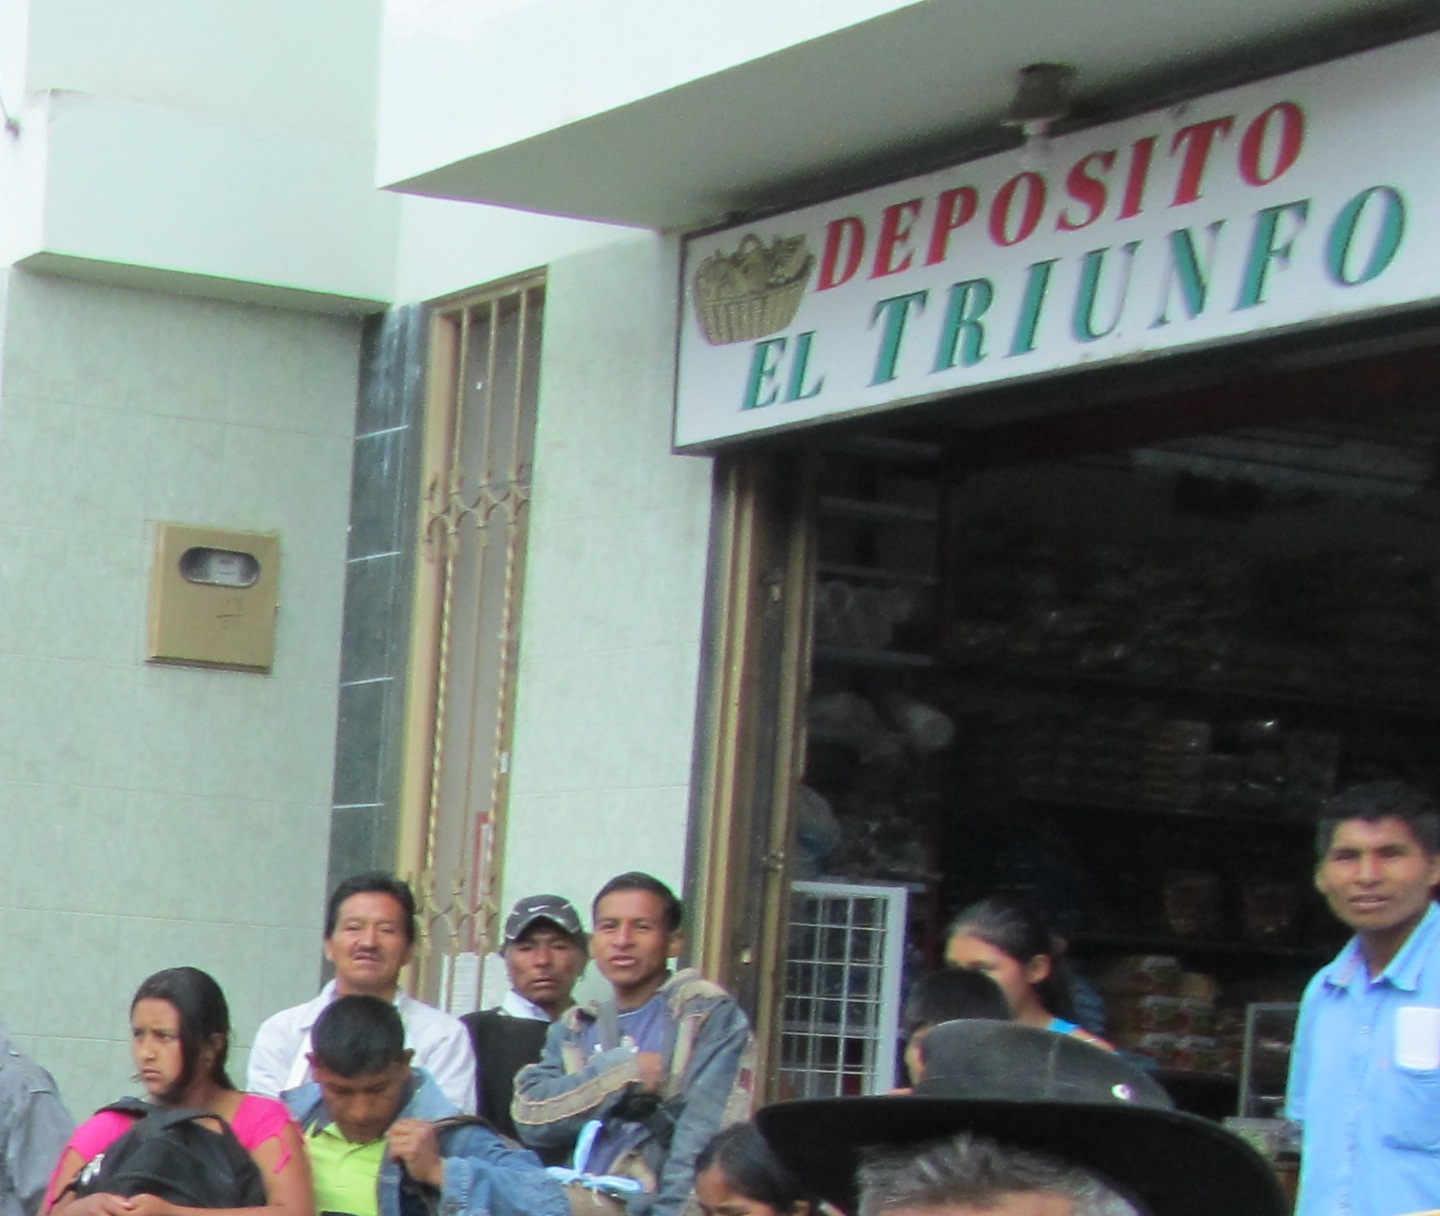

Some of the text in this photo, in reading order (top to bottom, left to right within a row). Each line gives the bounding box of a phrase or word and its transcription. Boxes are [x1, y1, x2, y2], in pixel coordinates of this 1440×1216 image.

[738, 184, 1408, 412] EL TRIUNFO
[814, 100, 1306, 293] DEPOSITO
